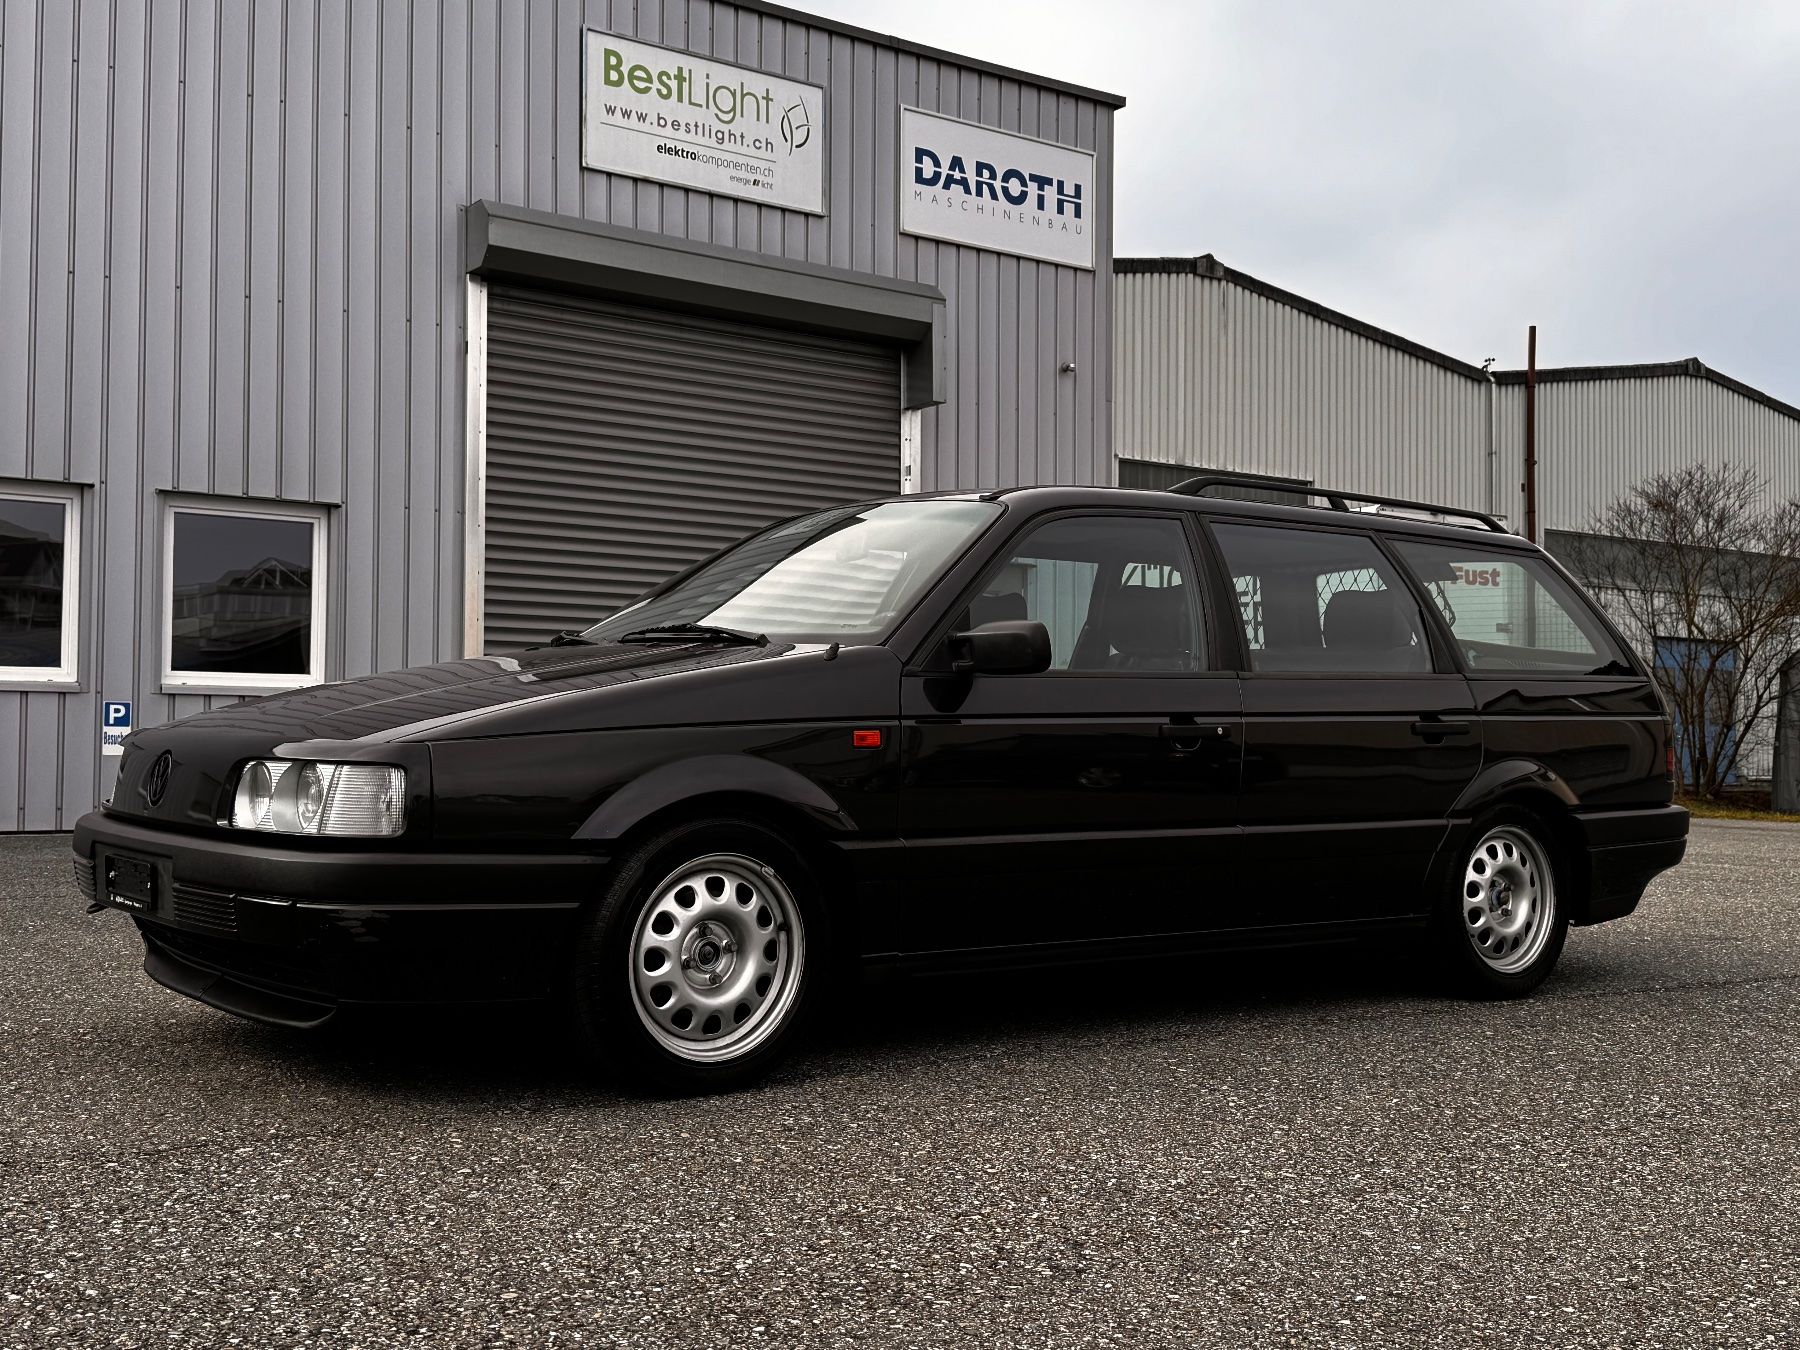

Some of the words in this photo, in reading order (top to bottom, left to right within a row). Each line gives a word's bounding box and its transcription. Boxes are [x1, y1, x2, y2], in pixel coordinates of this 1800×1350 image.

[603, 47, 774, 124] BestLight
[603, 103, 774, 153] www.bestlight.ch
[656, 143, 774, 178] elektrokomponenten.ch
[914, 145, 1082, 219] DAROTH
[914, 189, 1082, 235] MASCHINENBAU
[109, 704, 126, 725] P
